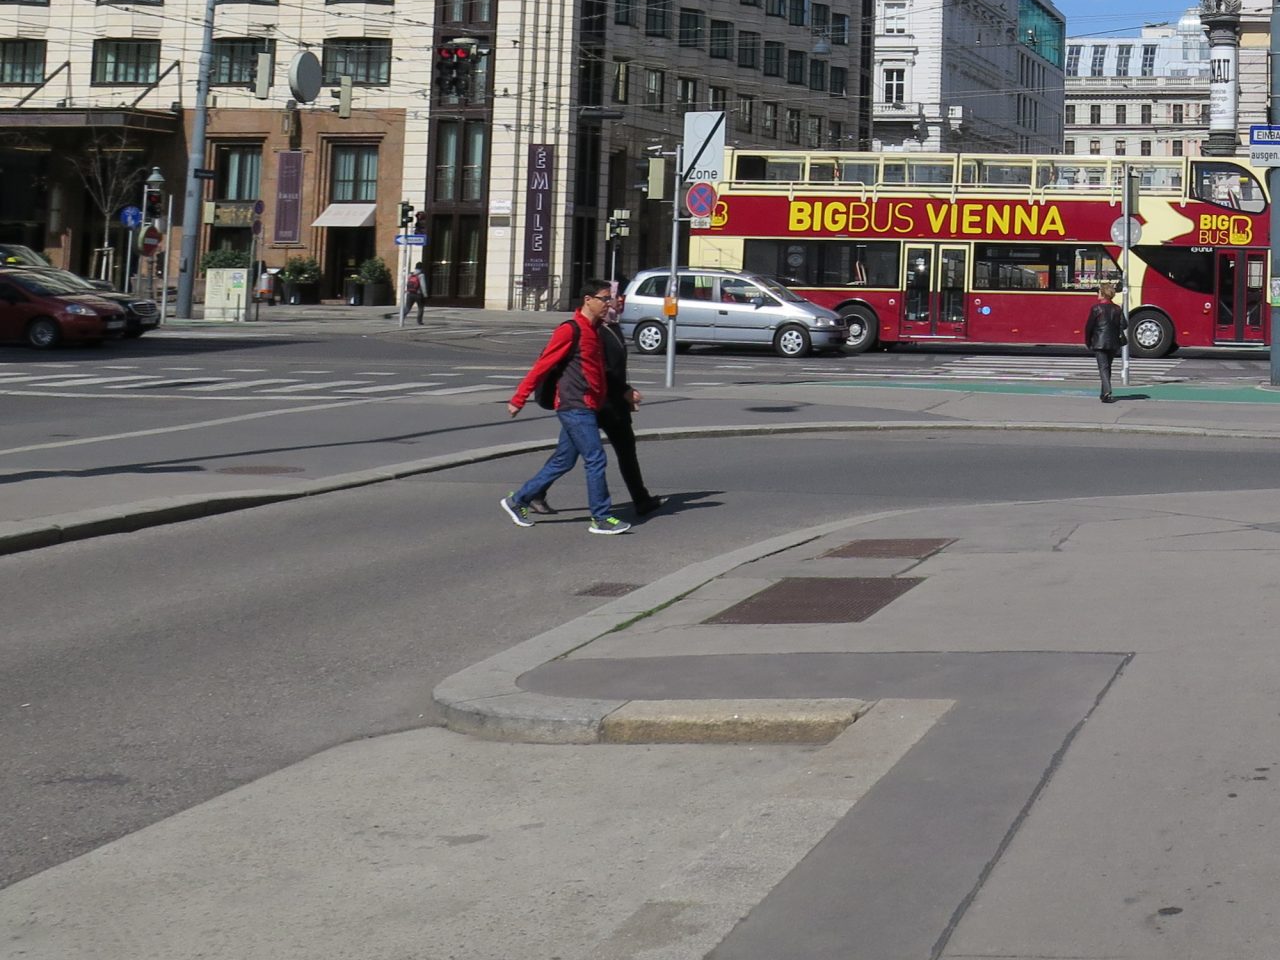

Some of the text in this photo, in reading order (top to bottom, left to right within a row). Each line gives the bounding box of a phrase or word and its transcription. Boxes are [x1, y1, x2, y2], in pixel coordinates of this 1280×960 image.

[1251, 151, 1280, 162] ausgen.
[688, 167, 718, 180] Zone
[926, 202, 1066, 236] VIENNA
[1199, 214, 1229, 230] BIG
[1199, 230, 1229, 245] BUS
